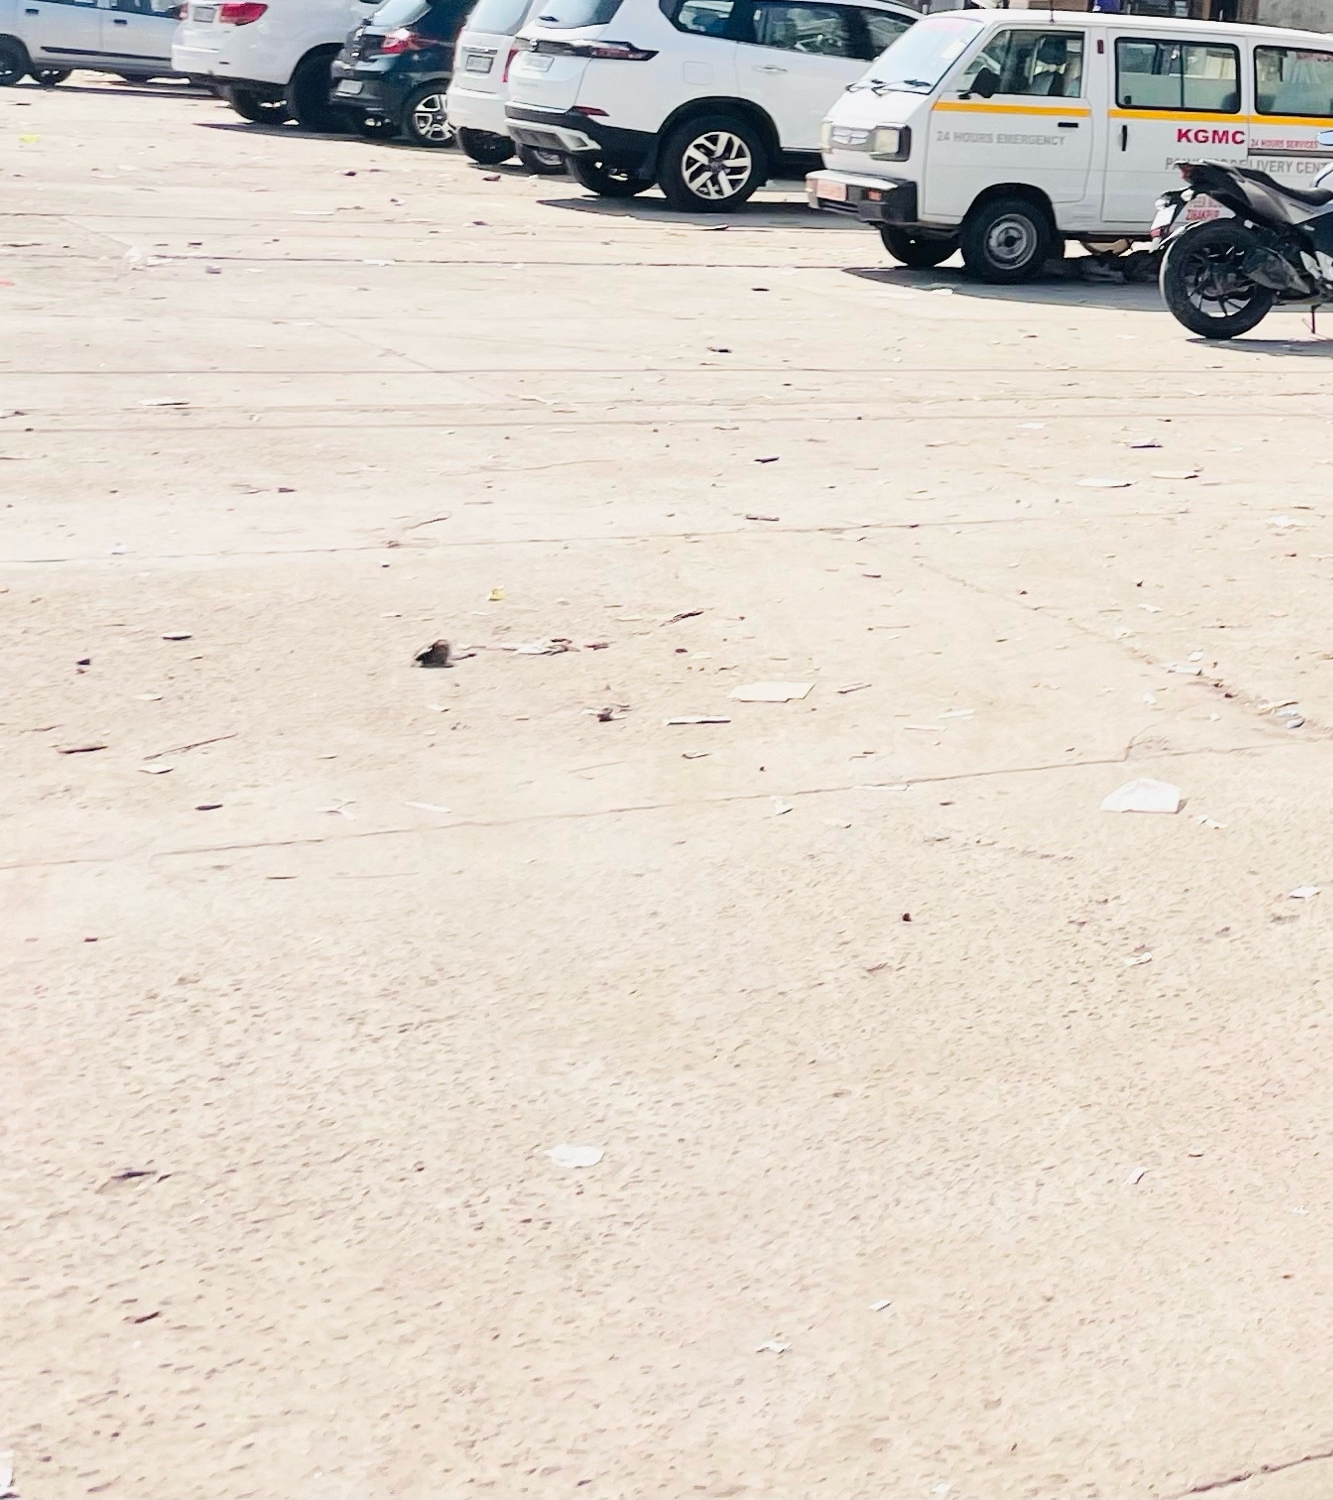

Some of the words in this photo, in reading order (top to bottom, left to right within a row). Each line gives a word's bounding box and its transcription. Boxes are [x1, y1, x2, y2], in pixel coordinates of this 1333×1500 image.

[936, 130, 950, 142] 24
[953, 131, 993, 144] HOURS
[996, 133, 1065, 146] EMERGENCY
[1176, 128, 1246, 145] KGMC
[1286, 140, 1319, 150] SERVICES
